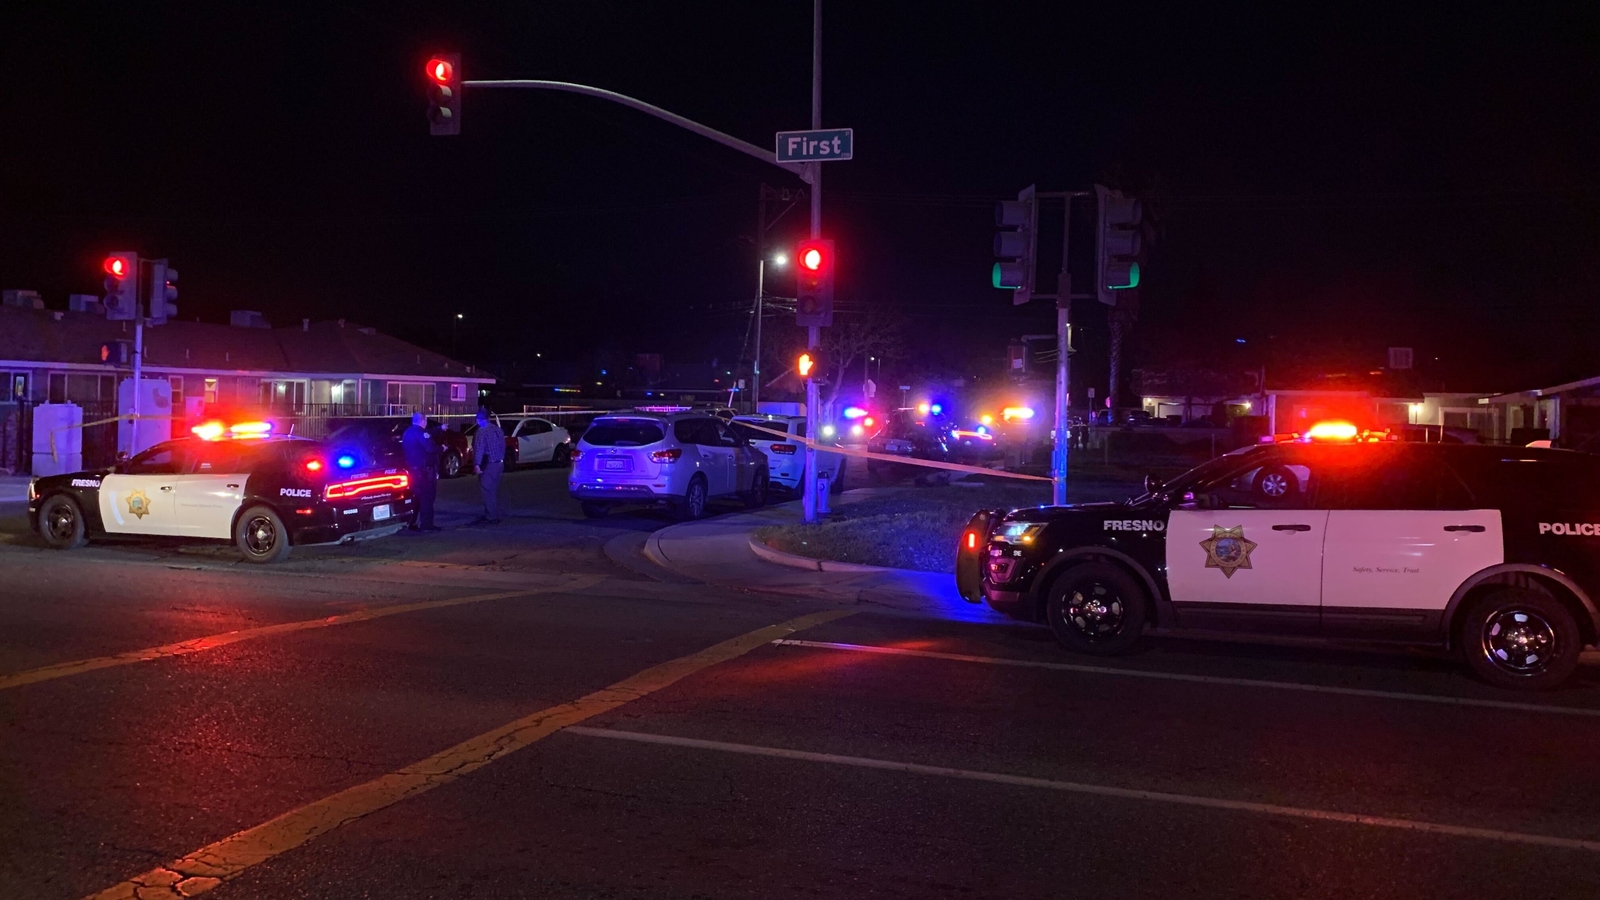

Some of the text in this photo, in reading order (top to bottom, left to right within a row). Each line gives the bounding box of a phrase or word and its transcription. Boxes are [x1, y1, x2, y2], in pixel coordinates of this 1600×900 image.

[788, 135, 841, 156] First
[71, 478, 101, 488] FRESNO
[279, 487, 312, 498] POLICE
[1103, 519, 1165, 532] FRESNO
[1352, 566, 1373, 574] Safety,
